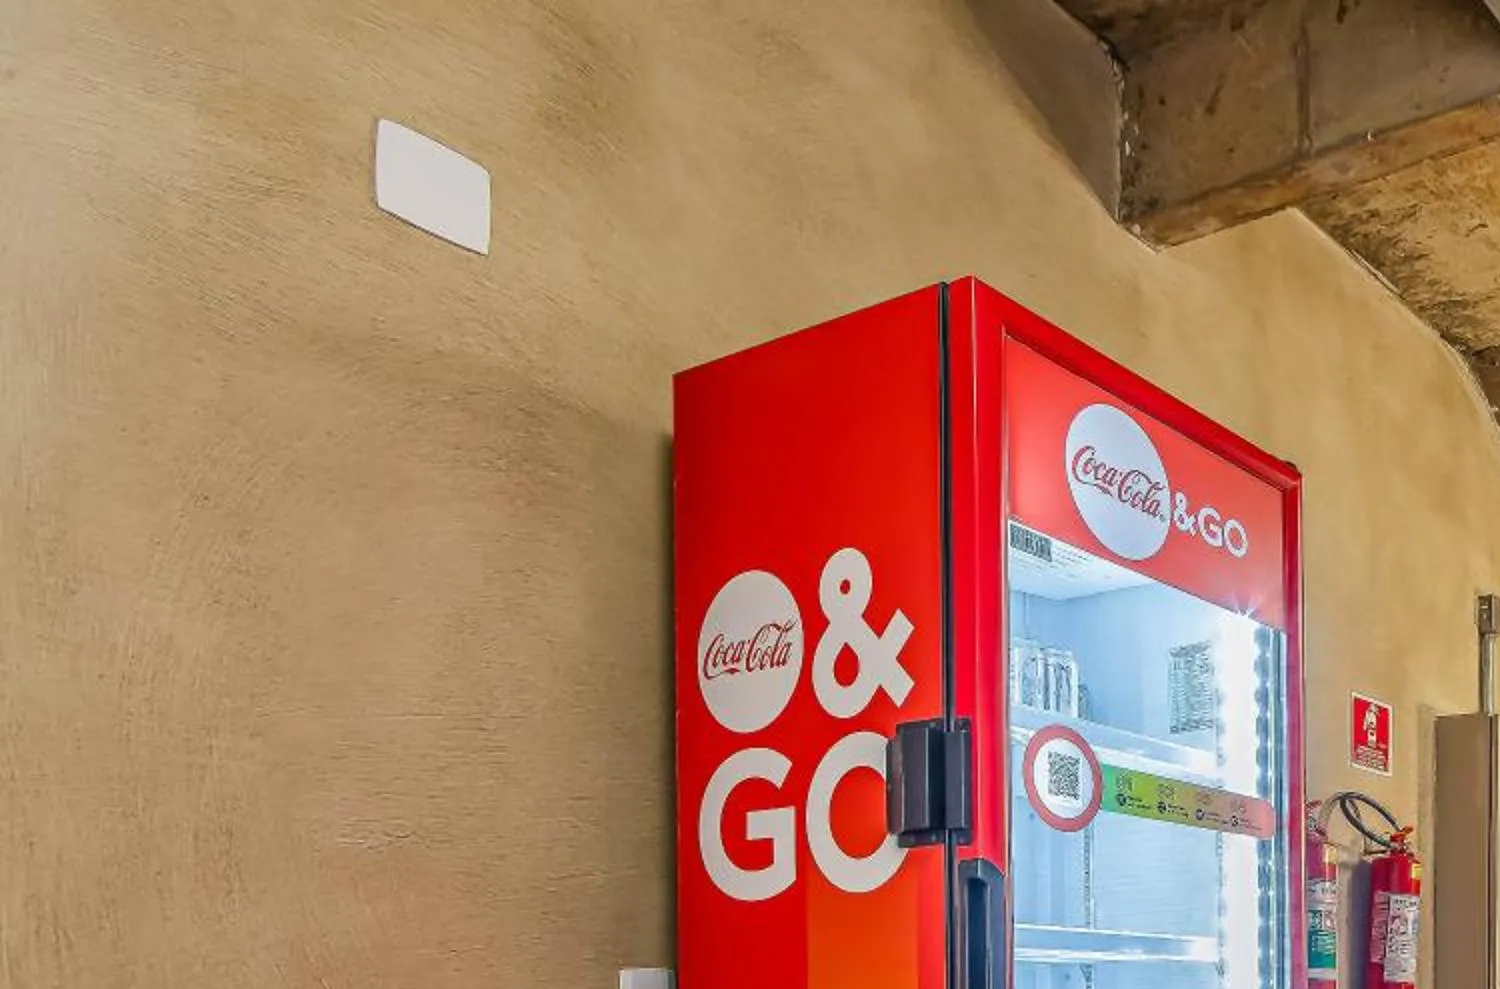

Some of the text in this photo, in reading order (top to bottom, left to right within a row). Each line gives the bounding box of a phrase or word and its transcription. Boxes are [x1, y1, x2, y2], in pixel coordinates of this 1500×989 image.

[1071, 445, 1167, 518] Coca-Cola
[703, 618, 798, 680] Coca-Cola
[698, 731, 909, 902] GO
